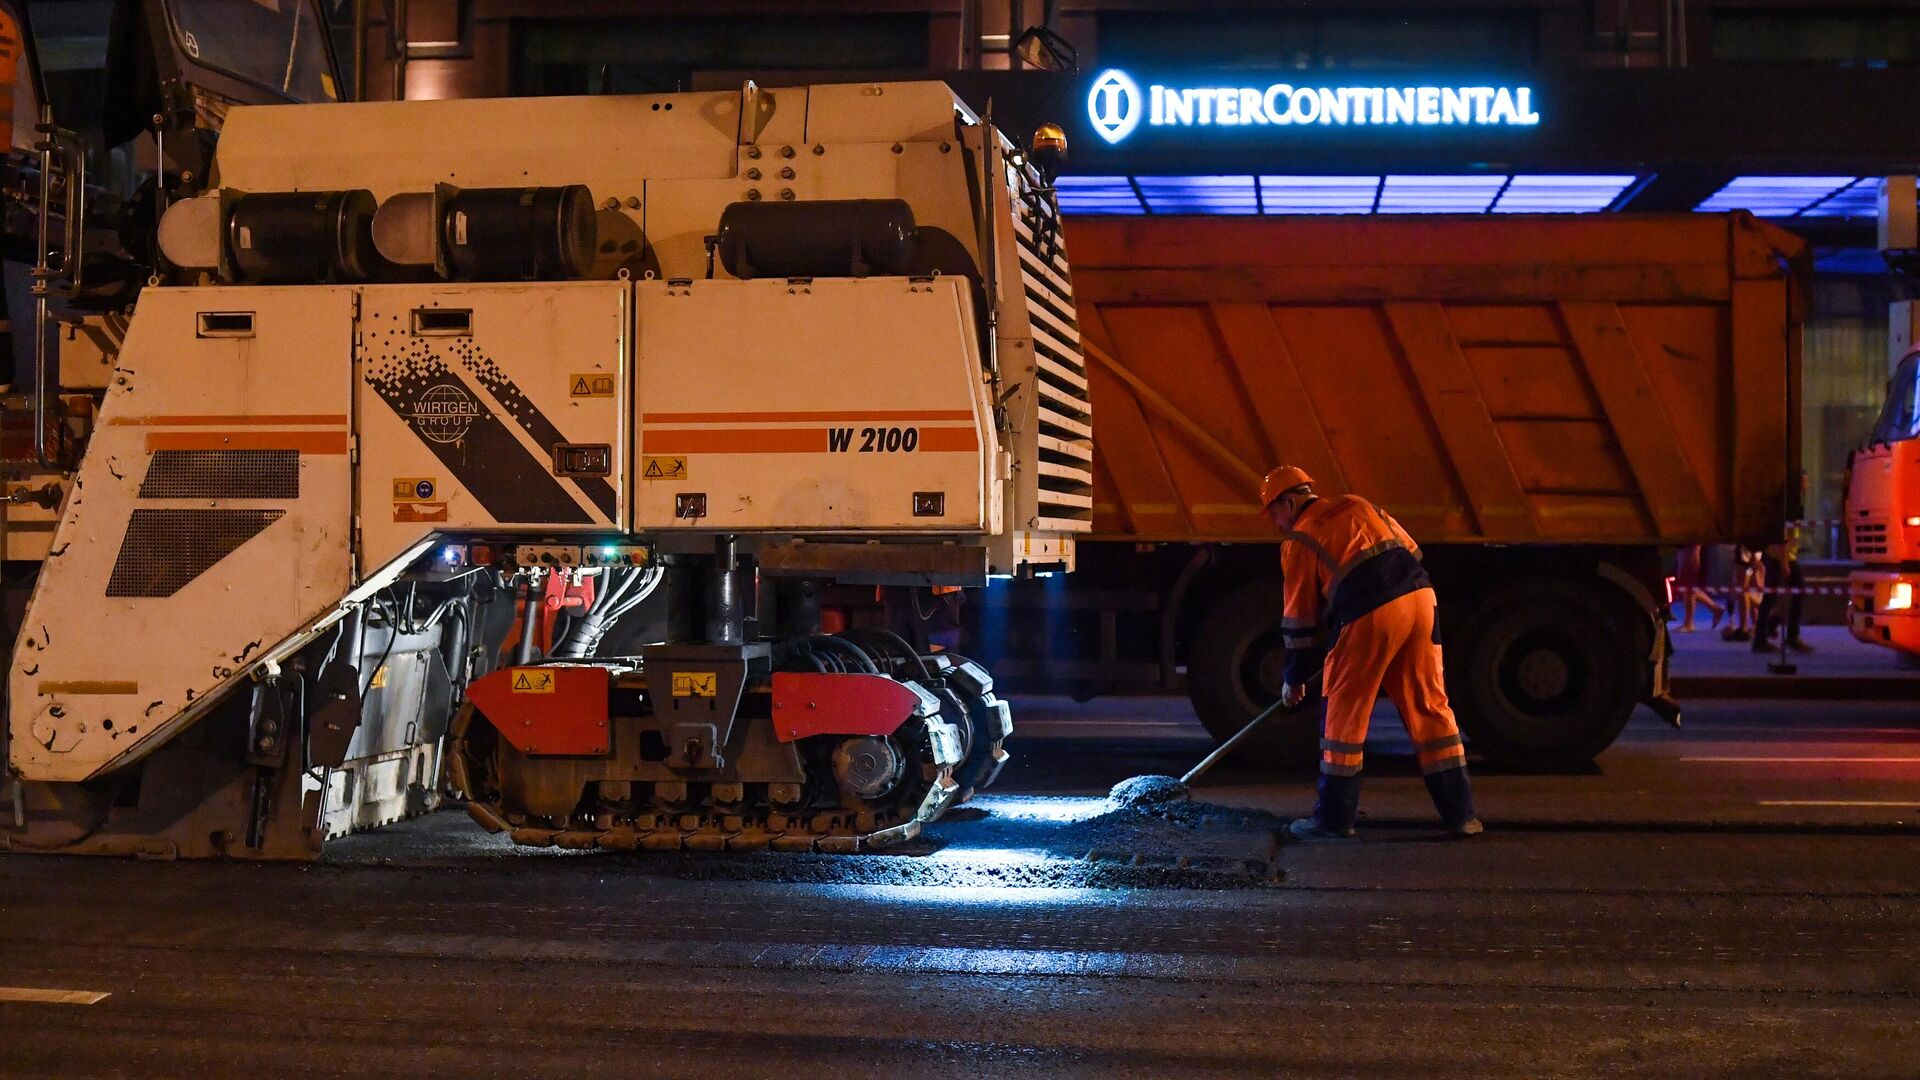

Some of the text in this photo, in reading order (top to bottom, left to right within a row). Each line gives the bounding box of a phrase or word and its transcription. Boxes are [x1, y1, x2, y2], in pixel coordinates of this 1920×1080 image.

[413, 401, 478, 414] WIRTGEN
[417, 416, 473, 426] GROUP
[828, 427, 918, 453] W 2100
